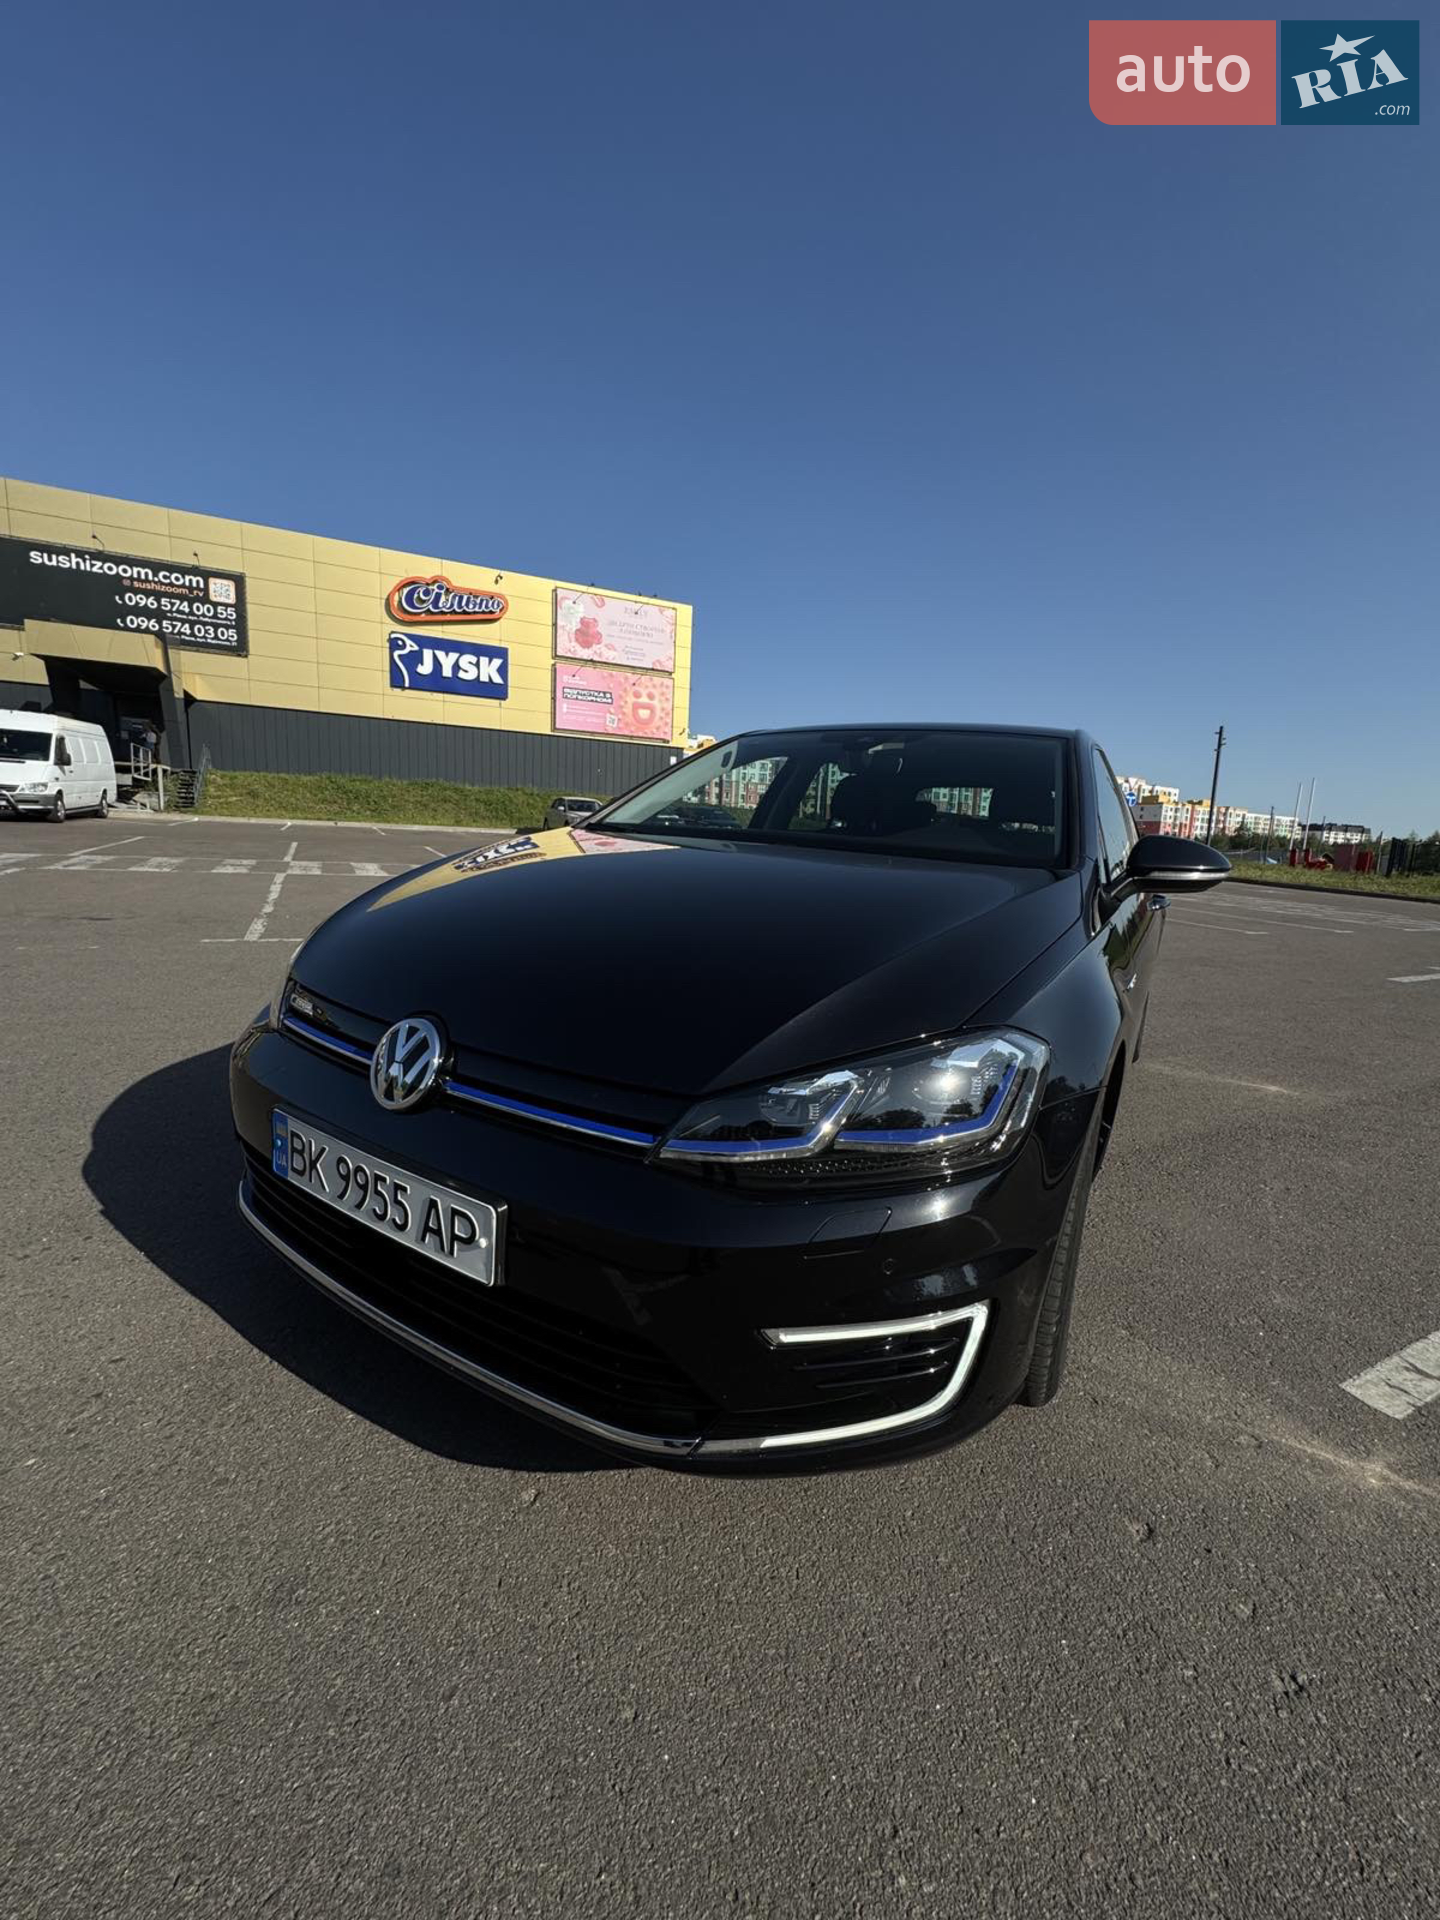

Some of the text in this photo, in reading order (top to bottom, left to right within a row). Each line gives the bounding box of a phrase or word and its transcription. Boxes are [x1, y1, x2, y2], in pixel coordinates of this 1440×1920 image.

[29, 551, 204, 588] sushizoom.com
[133, 580, 204, 597] sushizoom_rv
[401, 582, 504, 614] Сільпо
[124, 592, 158, 609] 096
[161, 598, 190, 613] 574
[193, 603, 214, 617] 00
[217, 606, 237, 620] 55
[126, 616, 159, 632] 096
[162, 620, 191, 636] 574
[194, 624, 215, 639] 03
[217, 627, 238, 642] 05
[416, 648, 505, 685] JYSK
[276, 1151, 287, 1167] UA
[289, 1130, 480, 1258] BK 9955 AP
